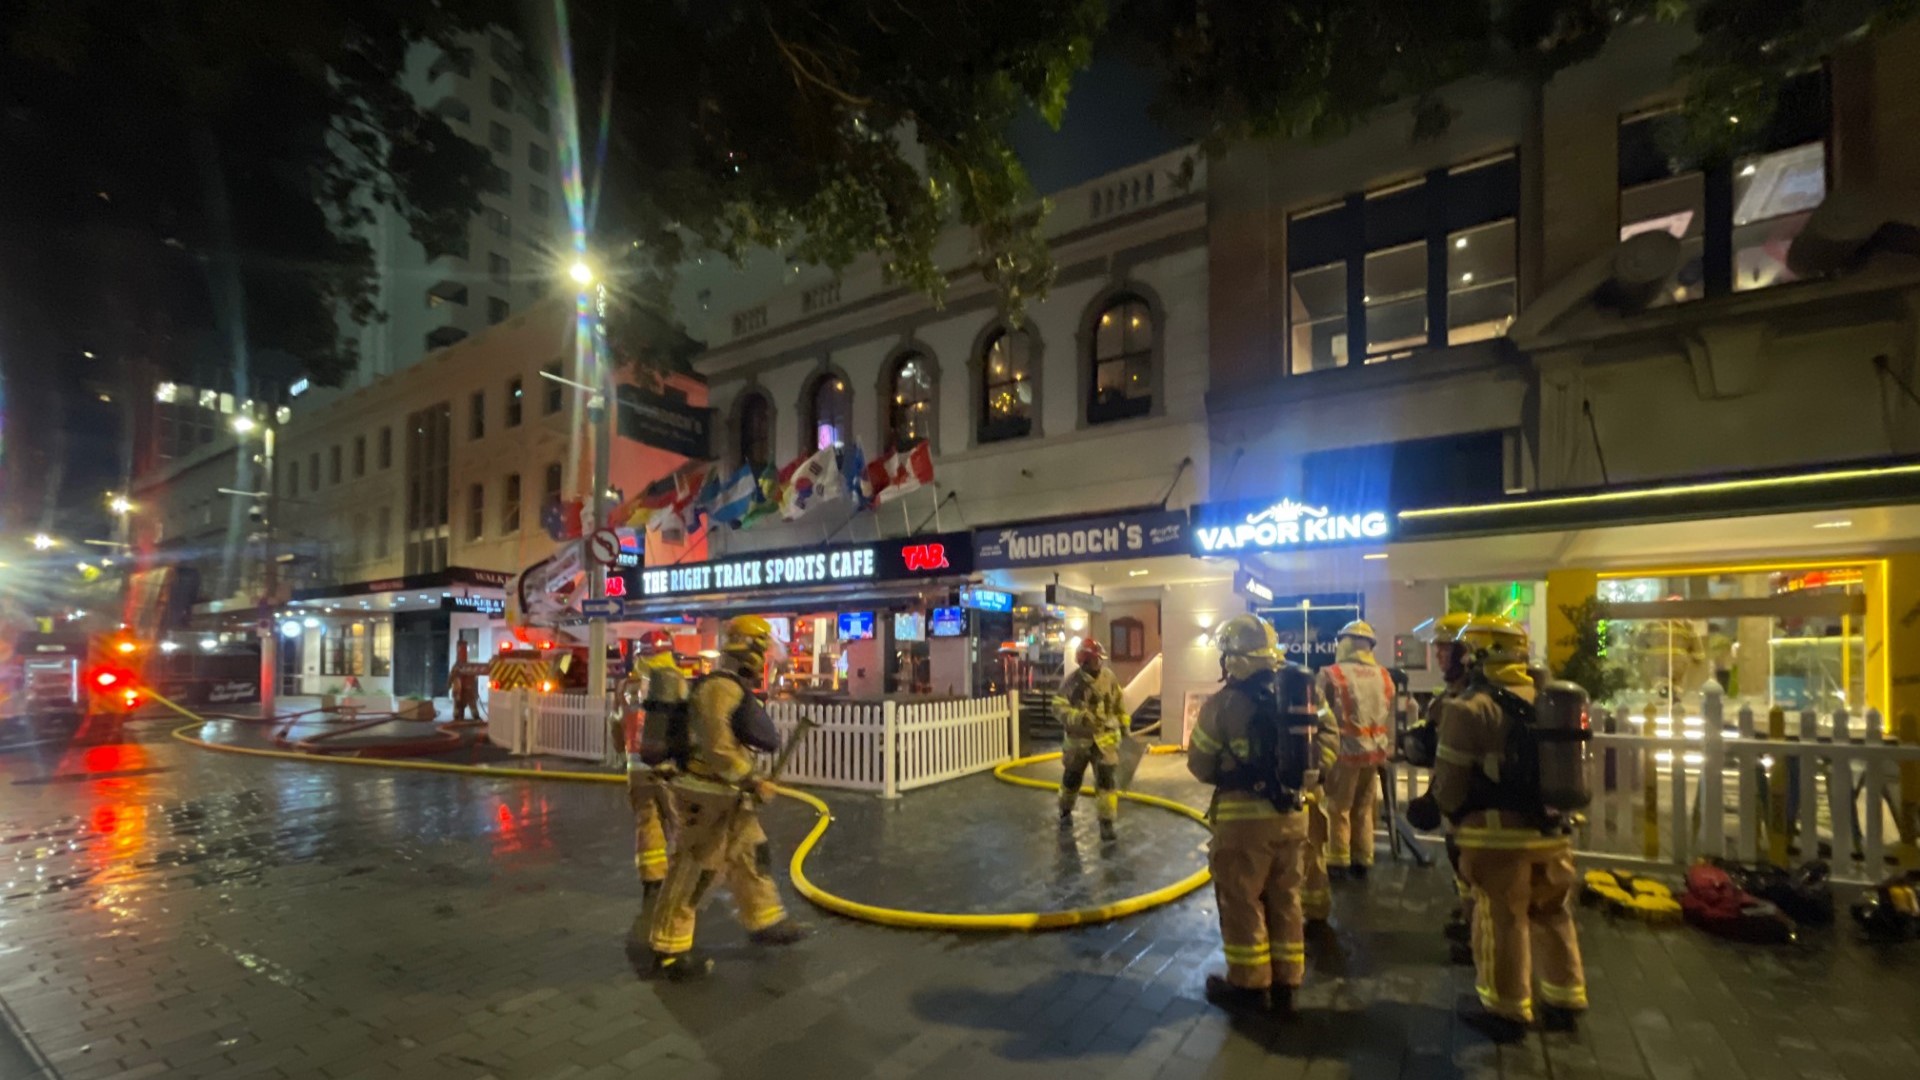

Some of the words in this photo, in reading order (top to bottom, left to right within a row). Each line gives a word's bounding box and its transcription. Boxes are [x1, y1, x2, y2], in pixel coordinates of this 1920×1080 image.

[1009, 522, 1142, 560] MURDOCH'S
[1198, 520, 1299, 550] VAPOR
[1304, 512, 1387, 542] KING
[643, 571, 668, 594] THE
[670, 566, 710, 591] RIGHT
[714, 561, 761, 588] TRACK
[765, 553, 826, 584] SPORTS
[830, 549, 874, 578] CAFE
